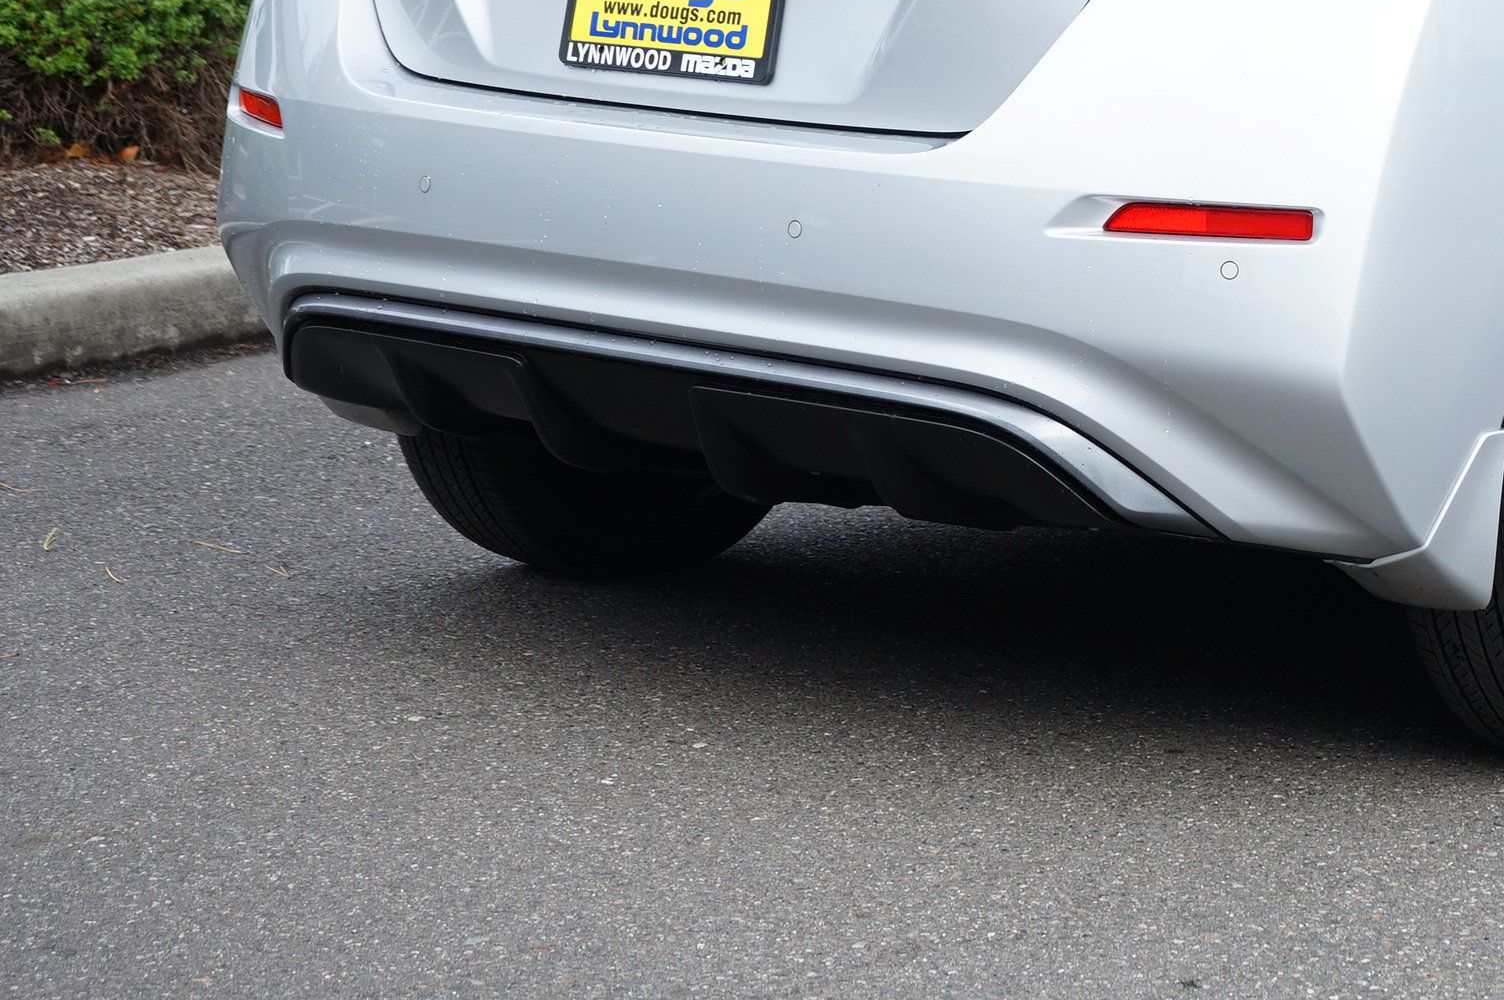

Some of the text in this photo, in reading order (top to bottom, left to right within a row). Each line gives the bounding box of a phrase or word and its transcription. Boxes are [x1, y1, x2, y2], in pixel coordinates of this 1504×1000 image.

[603, 0, 742, 26] www.dougs.com
[589, 11, 748, 50] Lynnwood
[566, 42, 672, 71] LYNNWOOD
